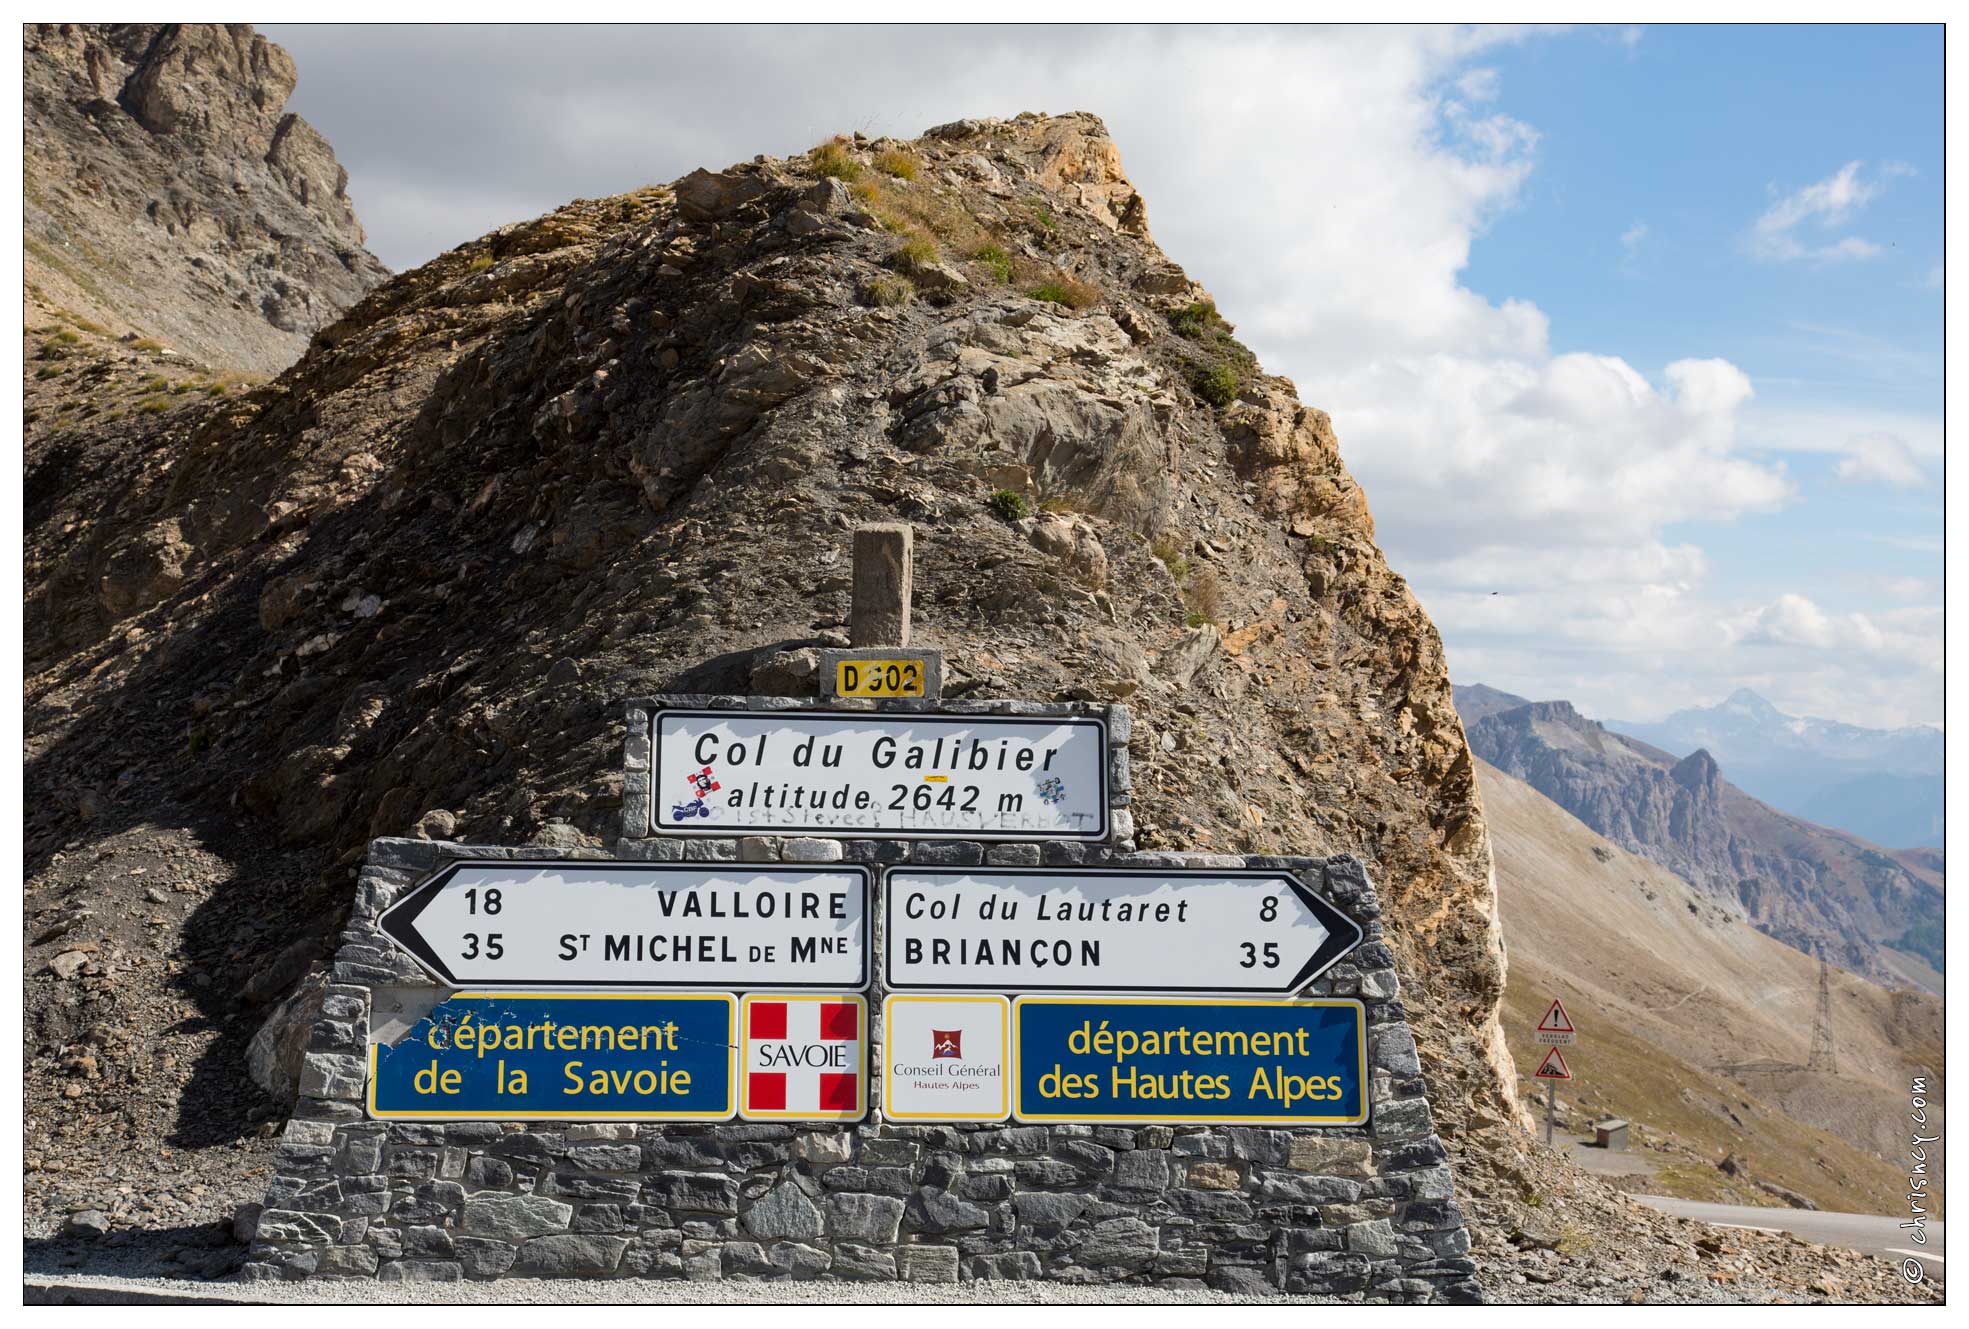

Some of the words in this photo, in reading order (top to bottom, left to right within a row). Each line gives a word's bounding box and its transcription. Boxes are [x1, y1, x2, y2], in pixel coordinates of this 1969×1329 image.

[845, 666, 858, 691] D
[869, 665, 917, 691] 902
[695, 733, 766, 765] Col
[793, 736, 842, 767] du
[872, 737, 1057, 771] Galibier
[728, 782, 863, 809] altitude
[888, 785, 979, 813] 2642
[998, 794, 1022, 812] m
[465, 889, 501, 915] 18
[658, 891, 846, 919] VALLOIRE
[906, 893, 960, 919] Col
[979, 894, 1017, 920] du
[1037, 895, 1187, 922] Lautaret
[1260, 896, 1278, 922] 8
[462, 933, 503, 960] 35
[605, 935, 736, 962] MICHEL
[750, 946, 775, 962] DE
[906, 939, 1099, 967] BRIANÇON
[1240, 942, 1280, 968] 35
[760, 1045, 846, 1067] SAVOIE
[1069, 1021, 1309, 1062] département
[414, 1061, 461, 1094] de
[498, 1060, 527, 1094] la
[564, 1061, 690, 1094] Savoie
[894, 1064, 942, 1075] Conseil
[949, 1064, 1000, 1076] Général
[915, 1081, 949, 1089] Hautes
[953, 1082, 979, 1091] Alpes
[1039, 1064, 1098, 1098] des
[1113, 1066, 1230, 1099] Hautes
[1248, 1066, 1342, 1108] Alpes
